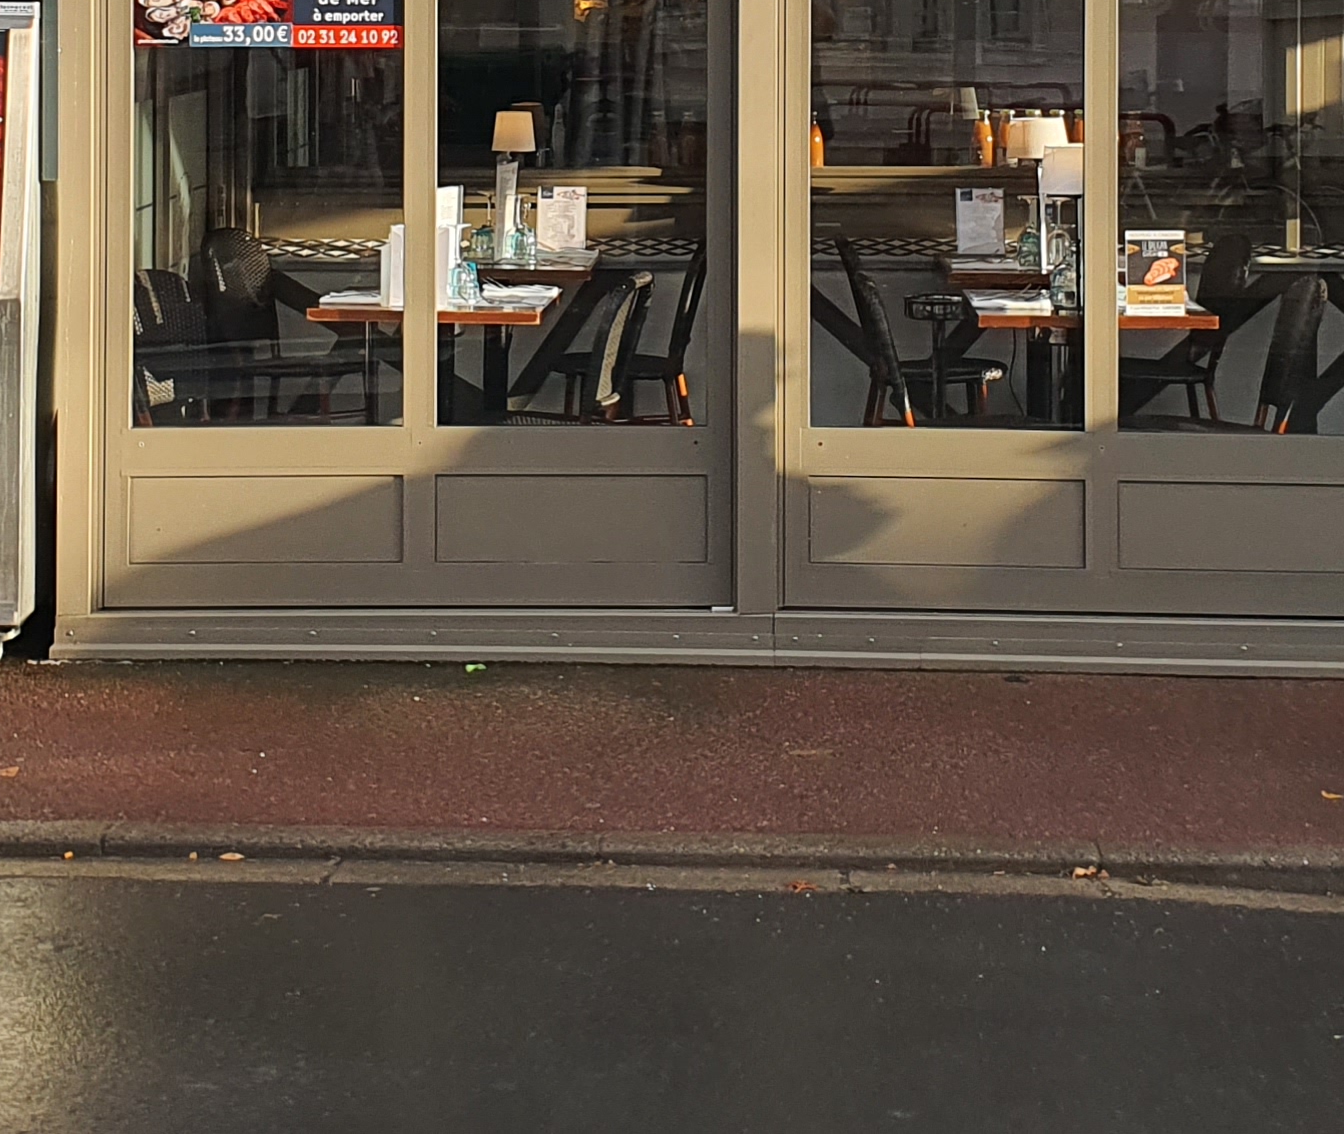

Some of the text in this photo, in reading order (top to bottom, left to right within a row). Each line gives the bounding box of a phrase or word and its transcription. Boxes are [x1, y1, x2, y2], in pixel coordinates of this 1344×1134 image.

[313, 8, 384, 24] à emporter
[298, 29, 398, 44] 02 31 24 10 92
